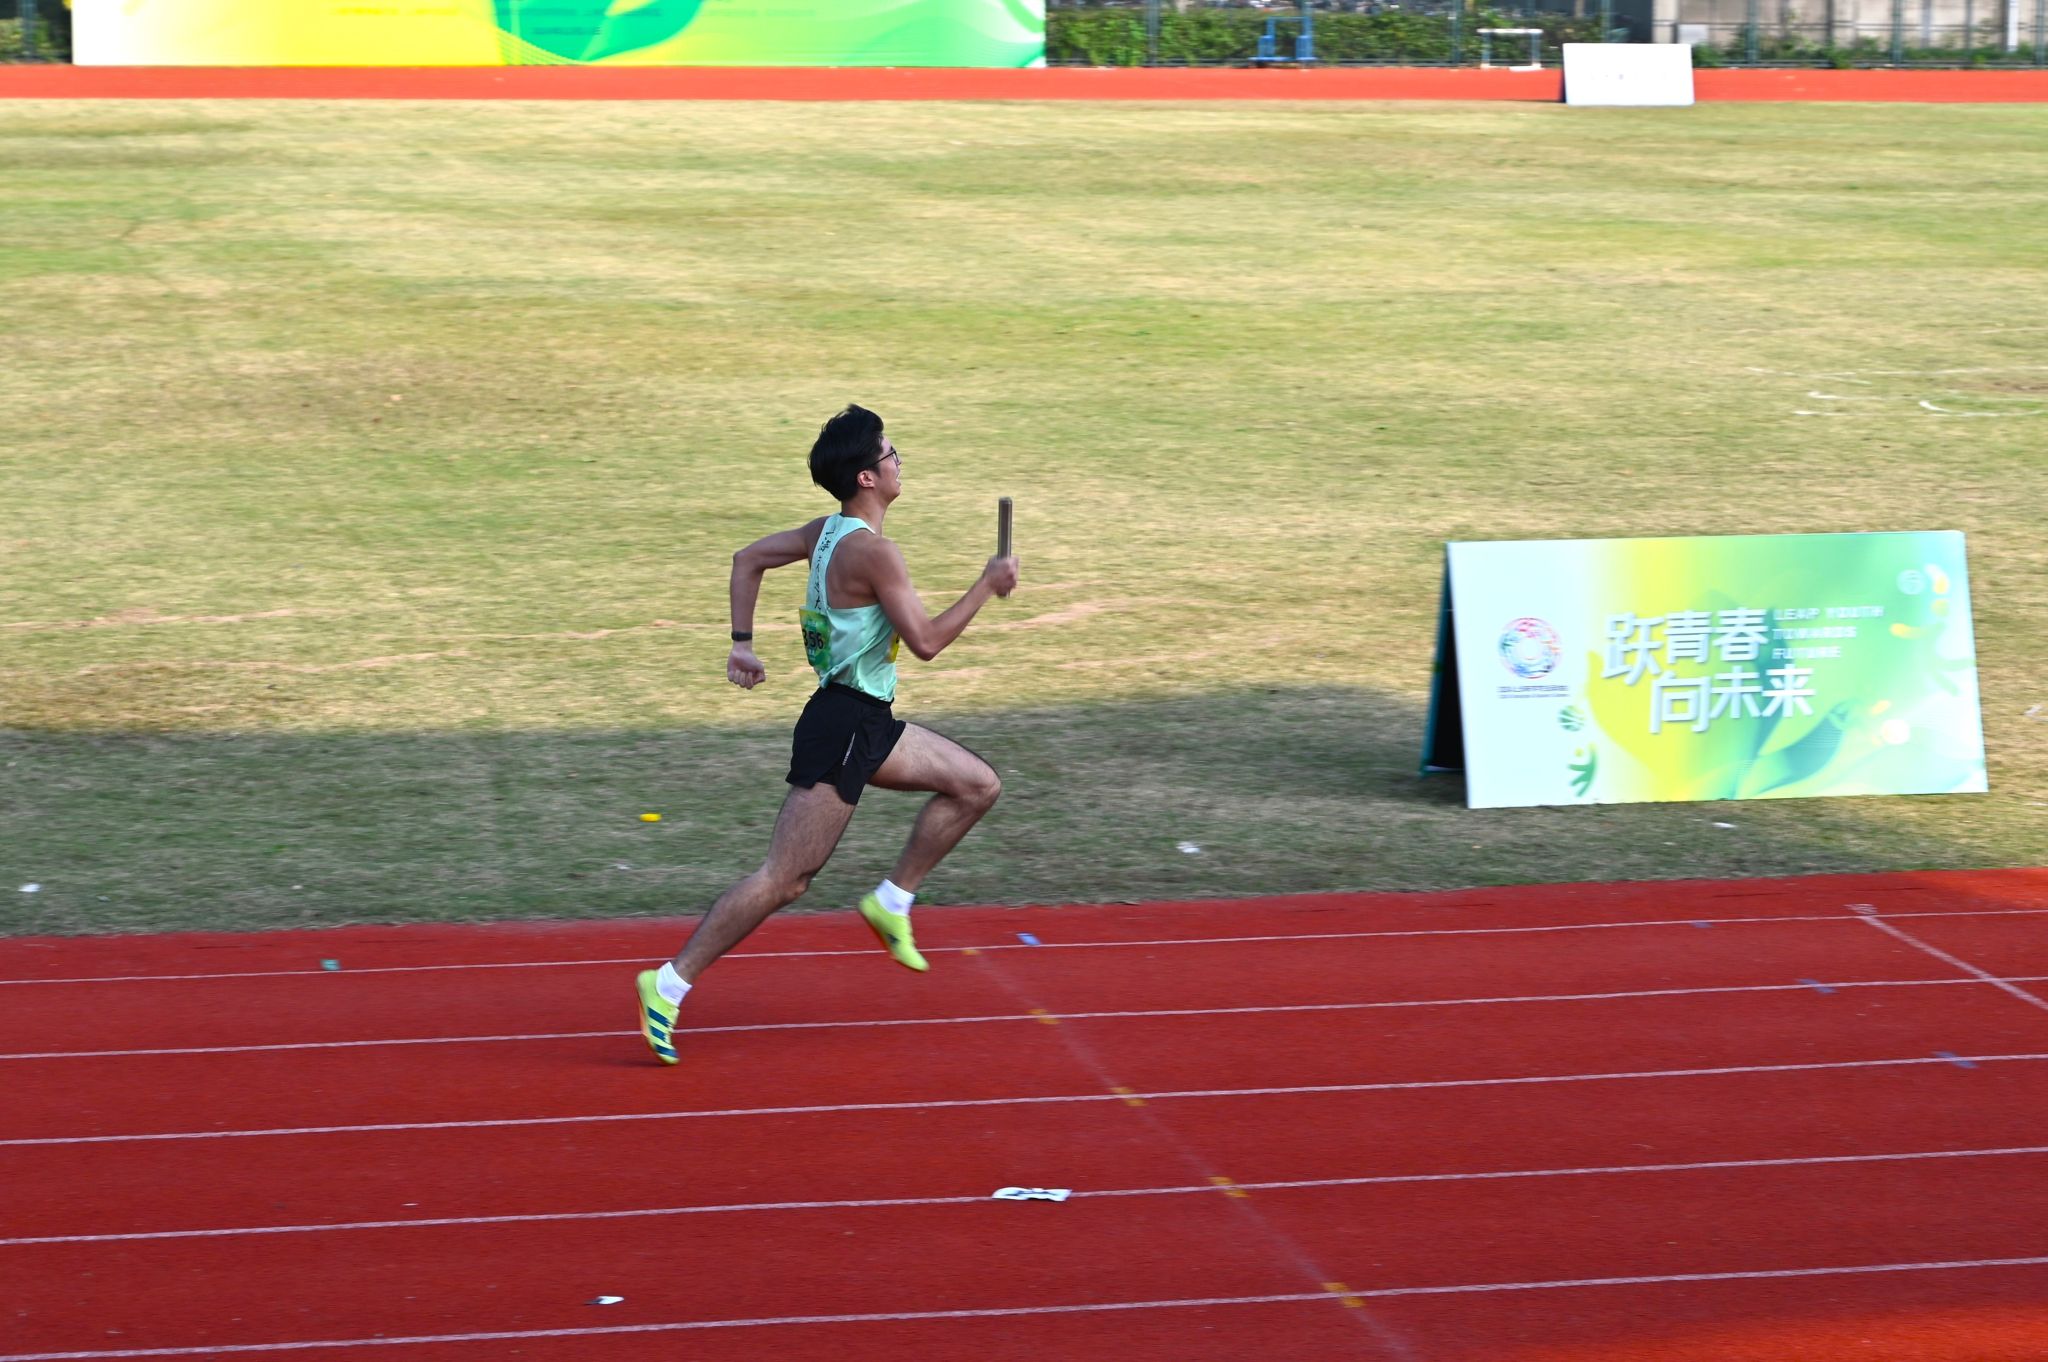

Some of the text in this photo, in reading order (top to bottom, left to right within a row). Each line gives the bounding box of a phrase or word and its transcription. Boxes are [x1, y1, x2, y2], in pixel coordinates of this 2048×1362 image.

[1600, 607, 1769, 687] 跃青春
[1649, 665, 1816, 734] 向未来
